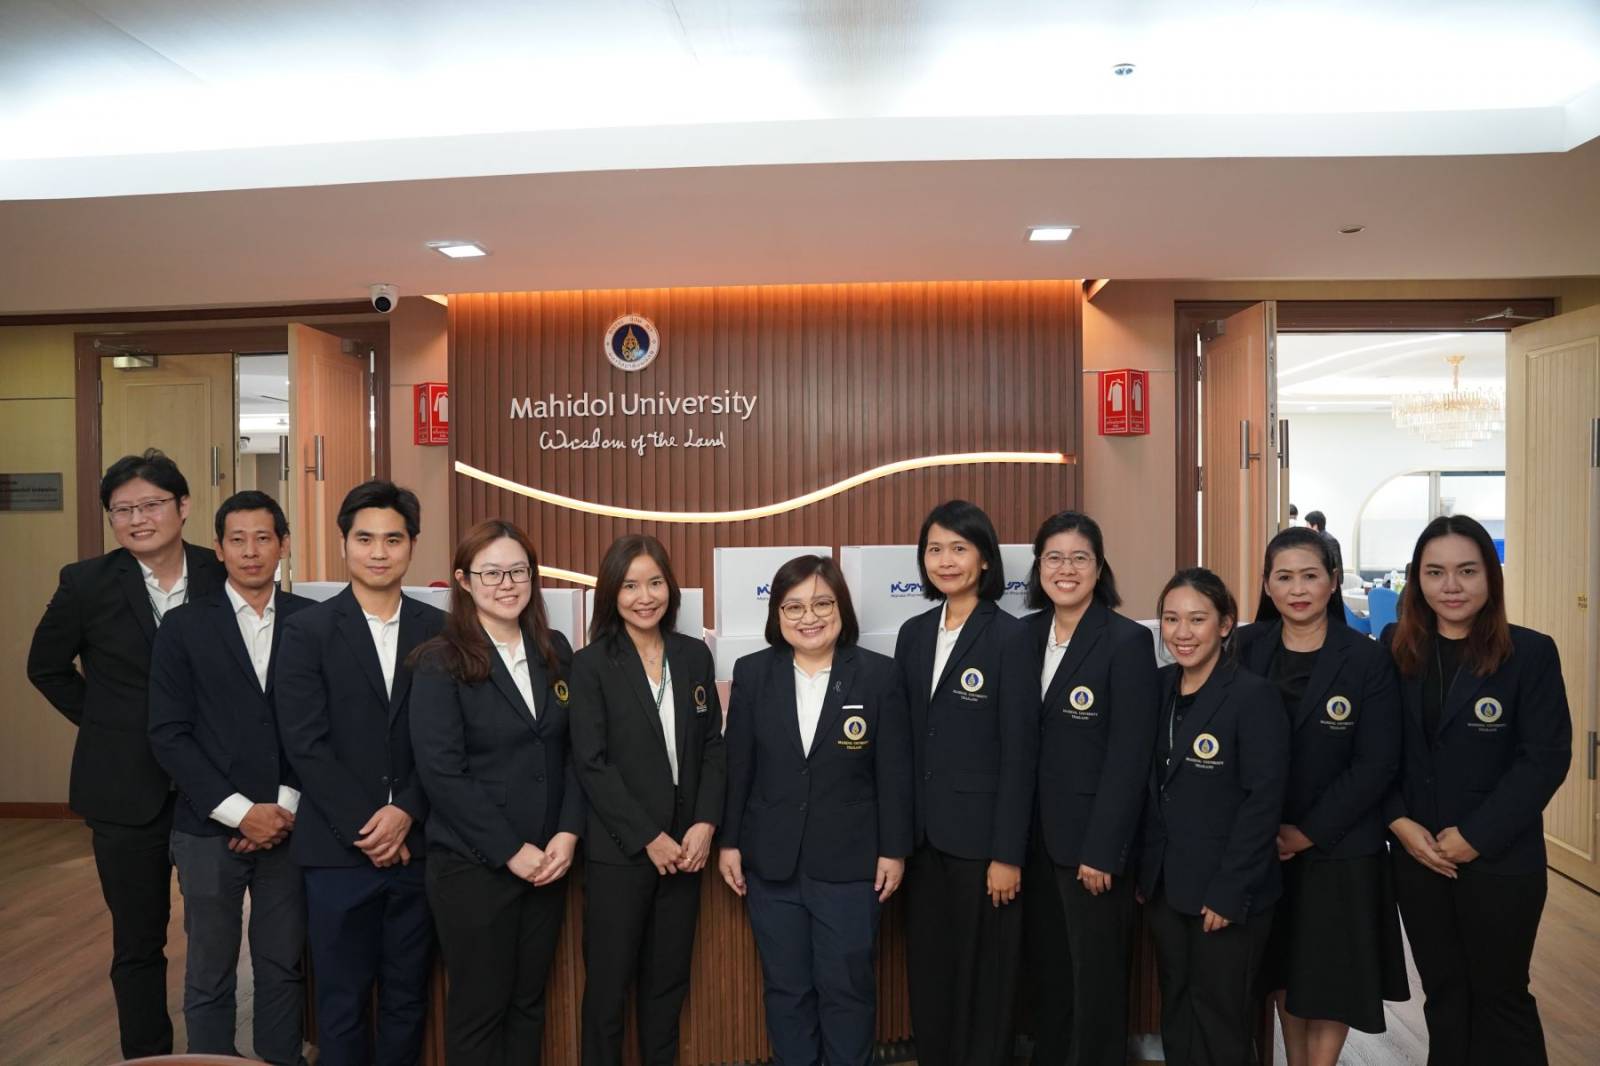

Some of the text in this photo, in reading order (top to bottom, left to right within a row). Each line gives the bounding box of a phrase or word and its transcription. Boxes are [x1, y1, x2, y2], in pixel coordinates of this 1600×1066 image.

[510, 389, 757, 420] Mahidol University
[539, 427, 727, 456] Wisdom of the Land
